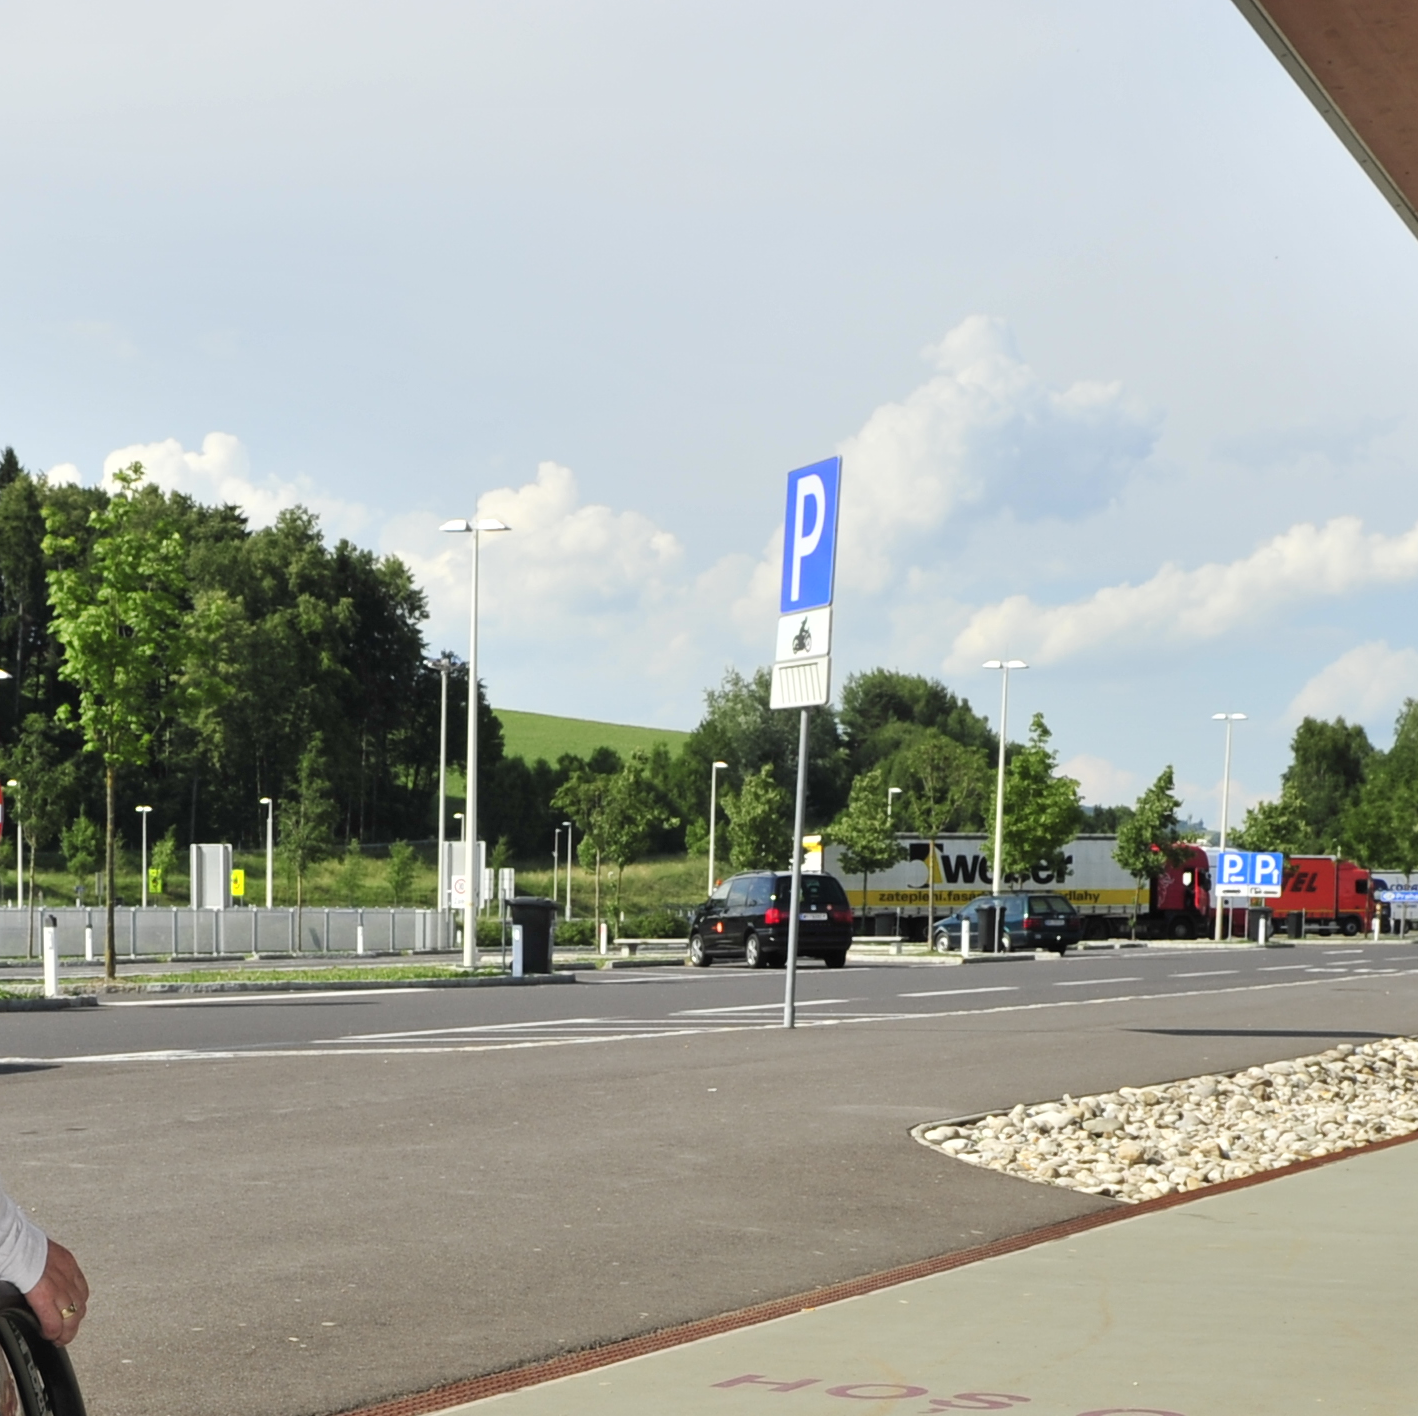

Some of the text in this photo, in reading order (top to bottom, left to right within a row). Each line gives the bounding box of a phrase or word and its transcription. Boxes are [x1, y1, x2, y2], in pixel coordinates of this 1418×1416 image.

[790, 473, 826, 603] P
[1222, 853, 1244, 883] P
[1254, 853, 1277, 885] P
